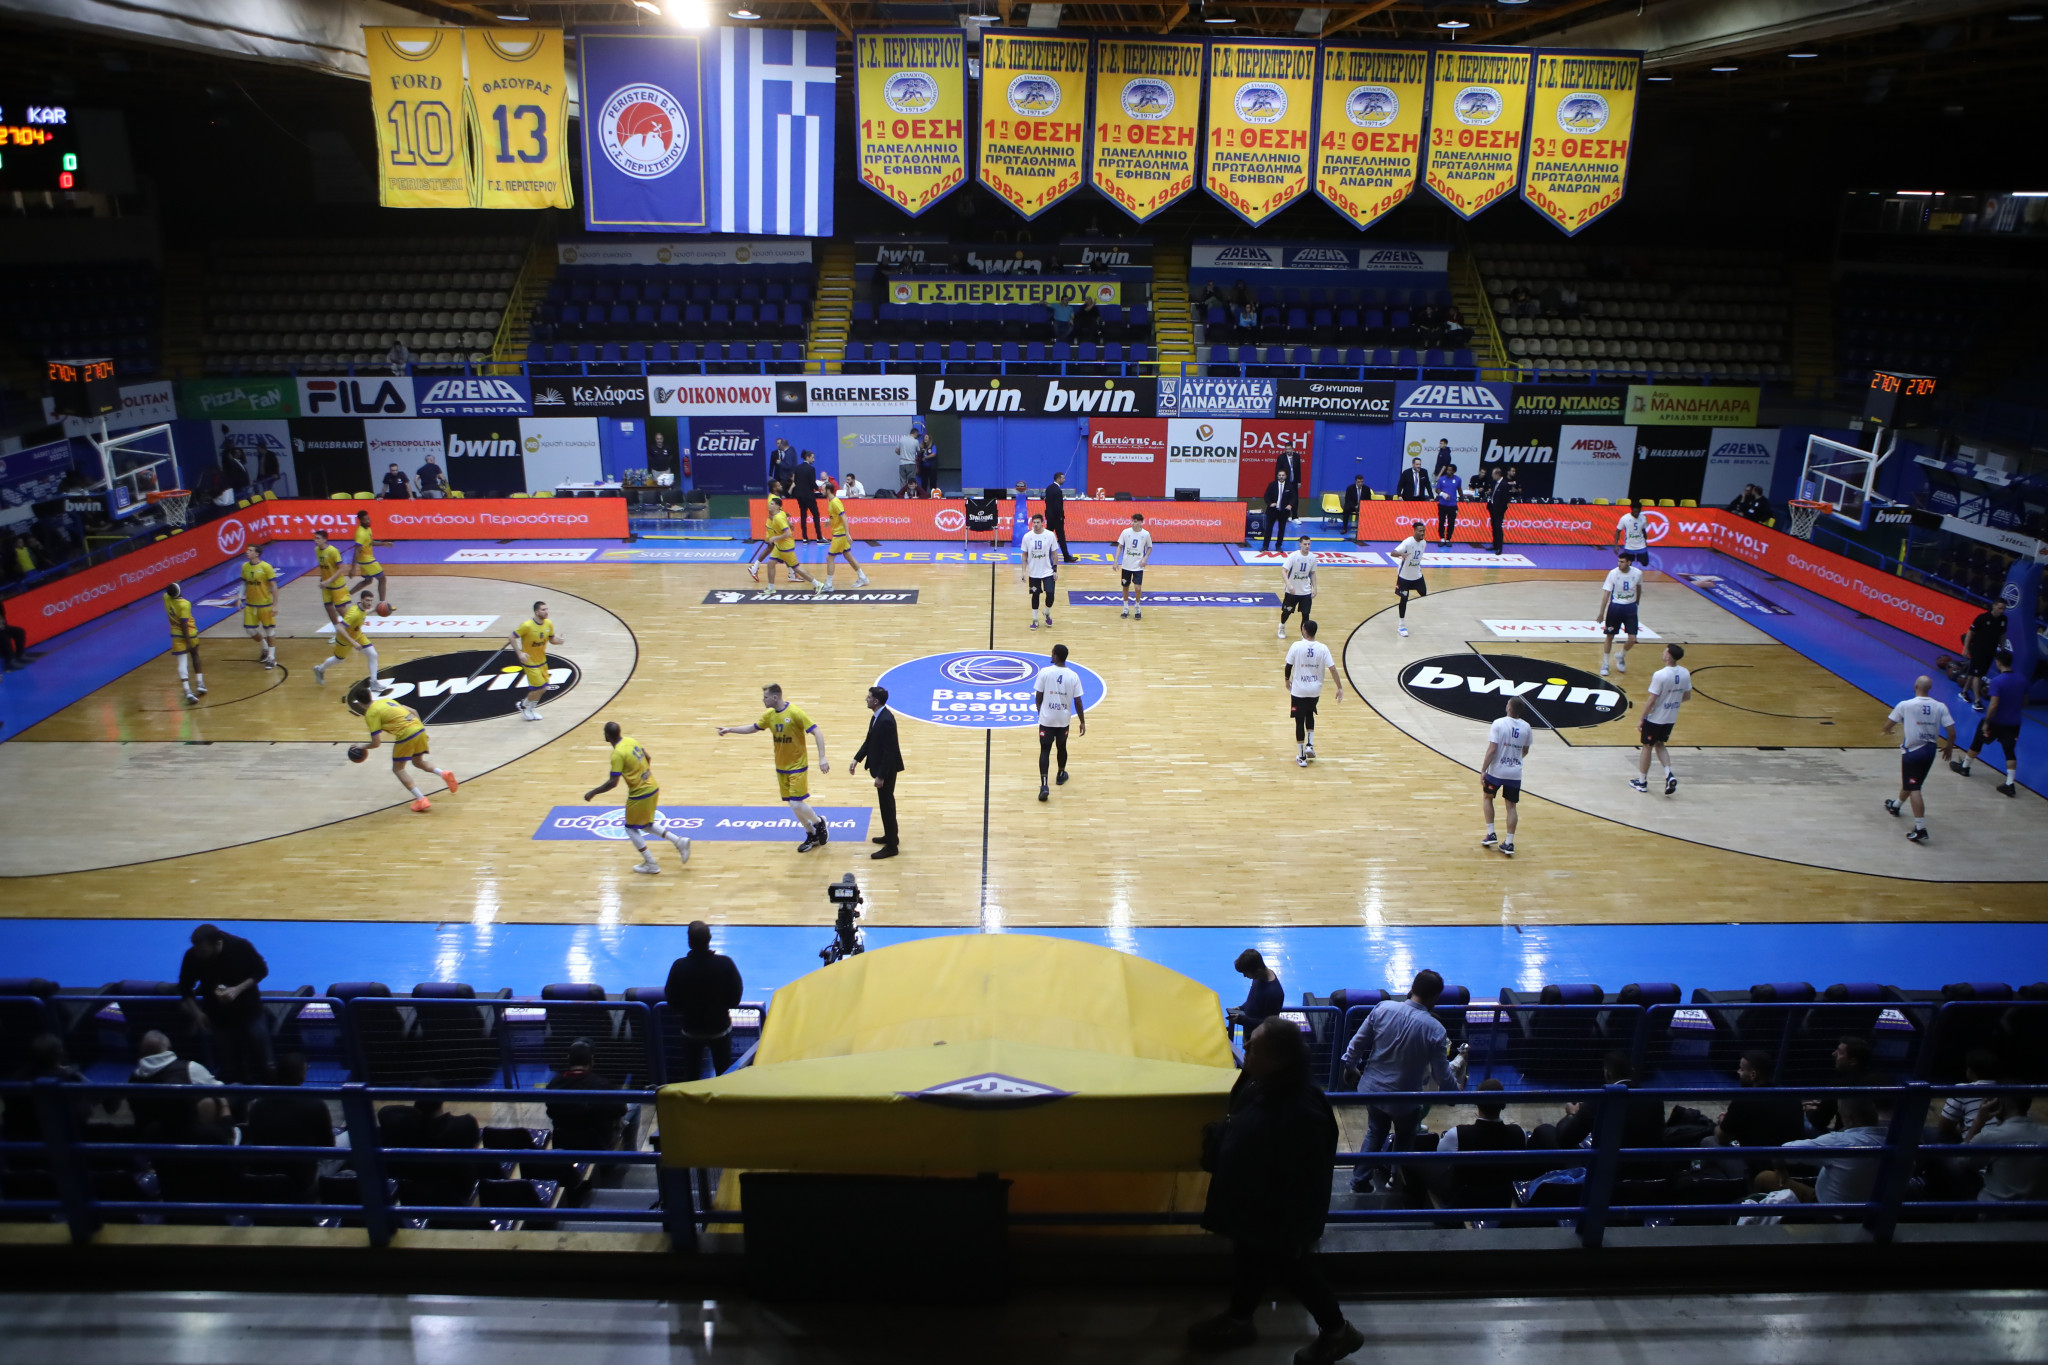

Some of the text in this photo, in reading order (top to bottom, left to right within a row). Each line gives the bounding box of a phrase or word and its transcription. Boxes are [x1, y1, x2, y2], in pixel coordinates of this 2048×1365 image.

[884, 38, 960, 68] ΠΕΡΙΣΤΕΡΙΟΥ
[1009, 40, 1087, 72] ΠΕΡΙΣΤΕΡΙΟΥ
[1123, 45, 1200, 76] ΠΕΡΙΣΤΕΡΙΟΥ
[1236, 48, 1314, 80] ΠΕΡΙΣΤΕΡΙΟΥ
[1348, 51, 1425, 84] ΠΕΡΙΣΤΕΡΙΟΥ
[1458, 55, 1527, 85] ΠΕΡΙΣΤΕΡΙΟΥ
[1560, 59, 1638, 90] ΠΕΡΙΣΤΕΡΙΟΥ
[390, 74, 443, 92] FORD
[482, 78, 553, 96] ΦΑΣΟΥΡΑΣ
[608, 91, 677, 120] PERISTERI B.C.
[27, 107, 67, 124] KAR
[388, 100, 453, 166] 10
[493, 104, 548, 164] 13
[892, 119, 962, 139] ΘΕΣΗ
[1014, 121, 1081, 143] ΘΕΣΗ
[1127, 125, 1194, 146] ΘΕΣΗ
[1240, 129, 1307, 150] ΘΕΣΗ
[1351, 132, 1418, 153] ΘΕΣΗ
[1459, 129, 1519, 149] ΘΕΣΗ
[867, 143, 958, 153] ΠΑΝΕΛΛΗΝΙΟ
[988, 144, 1075, 157] ΠΑΝΕΛΛΗΝΙΟ
[1101, 148, 1187, 161] ΠΑΝΕΛΛΗΝΙΟ
[1561, 138, 1627, 160] ΘΕΣΗ
[624, 142, 682, 173] ΠΕΡΙΣΤΕΡΙΟΥ
[864, 154, 960, 165] ΠΡΩΤΑΘΛΗΜΑ
[985, 155, 1076, 168] ΠΡΩΤΑΘΛΗΜΑ
[1215, 152, 1301, 164] ΠΑΝΕΛΛΗΝΙΟ
[1325, 155, 1411, 167] ΠΑΝΕΛΛΗΝΙΟ
[1435, 151, 1512, 161] ΠΑΝΕΛΛΗΝΙΟ
[884, 164, 942, 175] ΕΦΗΒΩΝ
[1098, 158, 1189, 171] ΠΡΩΤΑΘΛΗΜΑ
[1212, 162, 1302, 175] ΠΡΩΤΑΘΛΗΜΑ
[1321, 165, 1412, 178] ΠΡΩΤΑΘΛΗΜΑ
[1431, 160, 1513, 171] ΠΡΩΤΑΘΛΗΜΑ
[1535, 161, 1619, 173] ΠΑΝΕΛΛΗΝΙΟ
[1006, 166, 1055, 178] ΠΑΙΔΩΝ
[1116, 169, 1170, 181] ΕΦΗΒΩΝ
[1229, 172, 1284, 185] ΕΦΗΒΩΝ
[1446, 170, 1495, 181] ΑΝΔΡΩΝ
[1532, 171, 1619, 183] ΠΡΩΤΑΘΛΗΜΑ
[389, 177, 464, 191] PERISTERI
[508, 179, 557, 193] ΠΕΡΙΣΤΕΡΙΟΥ
[1339, 176, 1393, 188] ΑΝΔΡΩΝ
[1548, 182, 1600, 193] ΑΝΔΡΩΝ
[1215, 247, 1272, 261] ARENA
[1292, 249, 1350, 263] ARENA
[1368, 250, 1423, 264] ARENA
[48, 364, 77, 382] 27:04
[84, 362, 114, 382] 27:04
[1182, 383, 1273, 396] ΑΥΓΟΥΛΕΑ
[1326, 385, 1363, 393] HYUNDAI
[1871, 372, 1901, 393] 27:04
[1906, 378, 1937, 396] 27:04
[307, 381, 406, 413] FILA
[422, 380, 526, 404] ARENA
[572, 386, 645, 404] Κελάφας
[678, 387, 771, 404] ΟΙΚΟΝΟΜΟΥ
[811, 388, 909, 401] GRGENESIS
[930, 378, 1023, 412] bwin
[1044, 379, 1136, 413] bwin
[1399, 385, 1504, 411] ARENA
[1181, 396, 1273, 409] ΛΙΝΑΡΔΑΤΟΥ
[1279, 396, 1390, 411] ΜΗΤΡΟΠΟΥΛΟΣ
[1514, 396, 1620, 410] AUTO NTANOS
[1651, 399, 1750, 413] ΜΑΝΔΗΛΑΡΑ
[1442, 412, 1503, 420] RENTAL
[308, 441, 364, 449] HAUSBRANDT
[448, 432, 517, 457] bwin
[697, 436, 759, 452] Cetilar
[1243, 432, 1307, 449] DASH
[1571, 439, 1616, 450] MEDIA
[1170, 446, 1237, 457] DEDRON
[1484, 439, 1553, 463] bwin
[1592, 451, 1621, 459] STROM
[1650, 448, 1707, 458] HAUSBRANDT
[1712, 443, 1770, 457] ARENA
[65, 498, 102, 512] bwin
[248, 515, 358, 532] WATT+VOLT
[390, 513, 589, 526] Φαντάσου Περισσότερα
[1148, 518, 1221, 527] Περισσότερα
[1875, 510, 1912, 524] bwin
[1132, 539, 1138, 548] 9
[1678, 522, 1769, 554] WATT+VOLT
[1035, 541, 1042, 550] 19
[638, 550, 742, 559] SUSTENIUM
[1300, 563, 1307, 572] 11
[42, 548, 197, 616] Φαντάσου Περισσότερα
[1623, 582, 1629, 590] 8
[1787, 553, 1945, 626] Φαντάσου Περισσότερα
[752, 593, 911, 602] HAUSBRANDT
[1307, 648, 1314, 658] 35
[1057, 675, 1062, 684] 4
[1408, 666, 1621, 707] bwin
[776, 724, 783, 732] 17
[1512, 727, 1519, 738] 16
